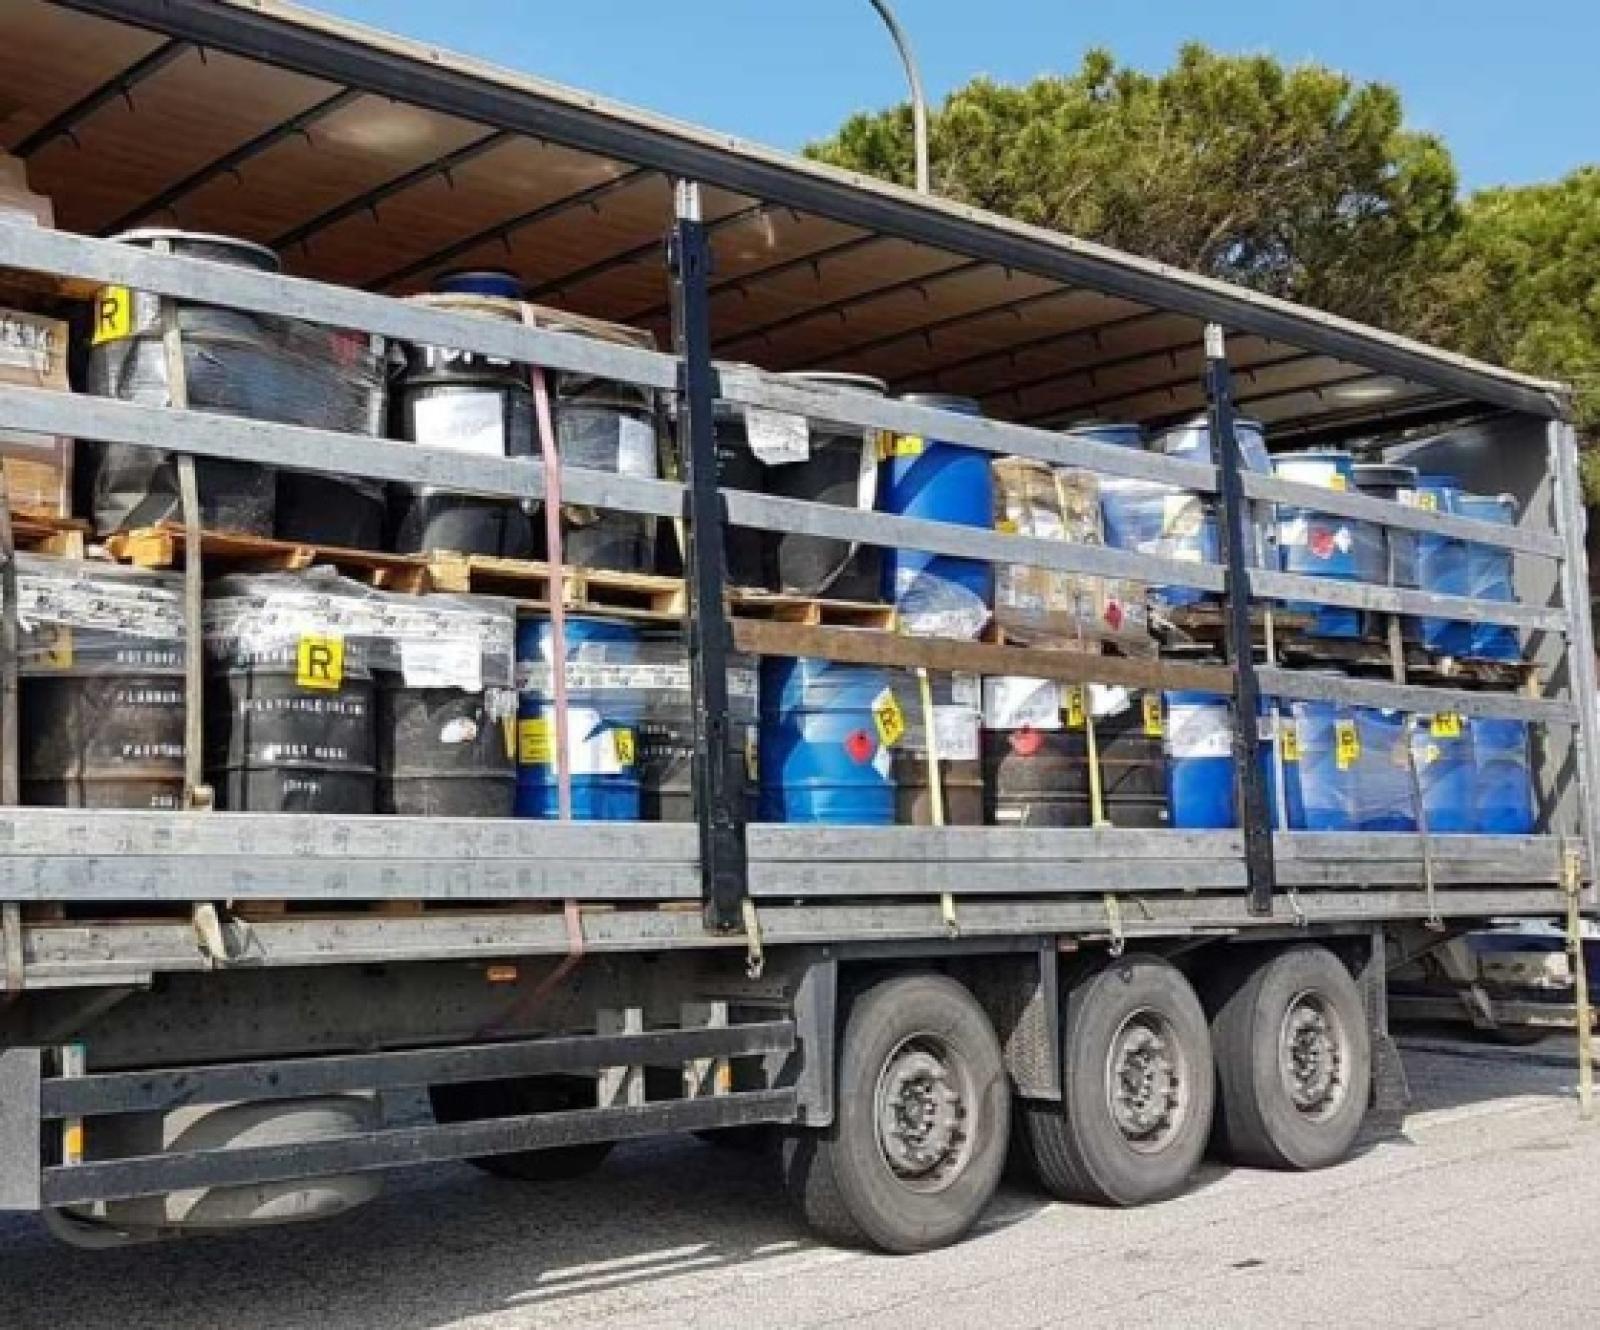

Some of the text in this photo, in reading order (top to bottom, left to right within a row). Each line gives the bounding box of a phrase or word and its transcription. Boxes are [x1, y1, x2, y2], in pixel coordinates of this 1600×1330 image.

[101, 297, 118, 334] R
[308, 644, 333, 680] R
[880, 707, 898, 736] R
